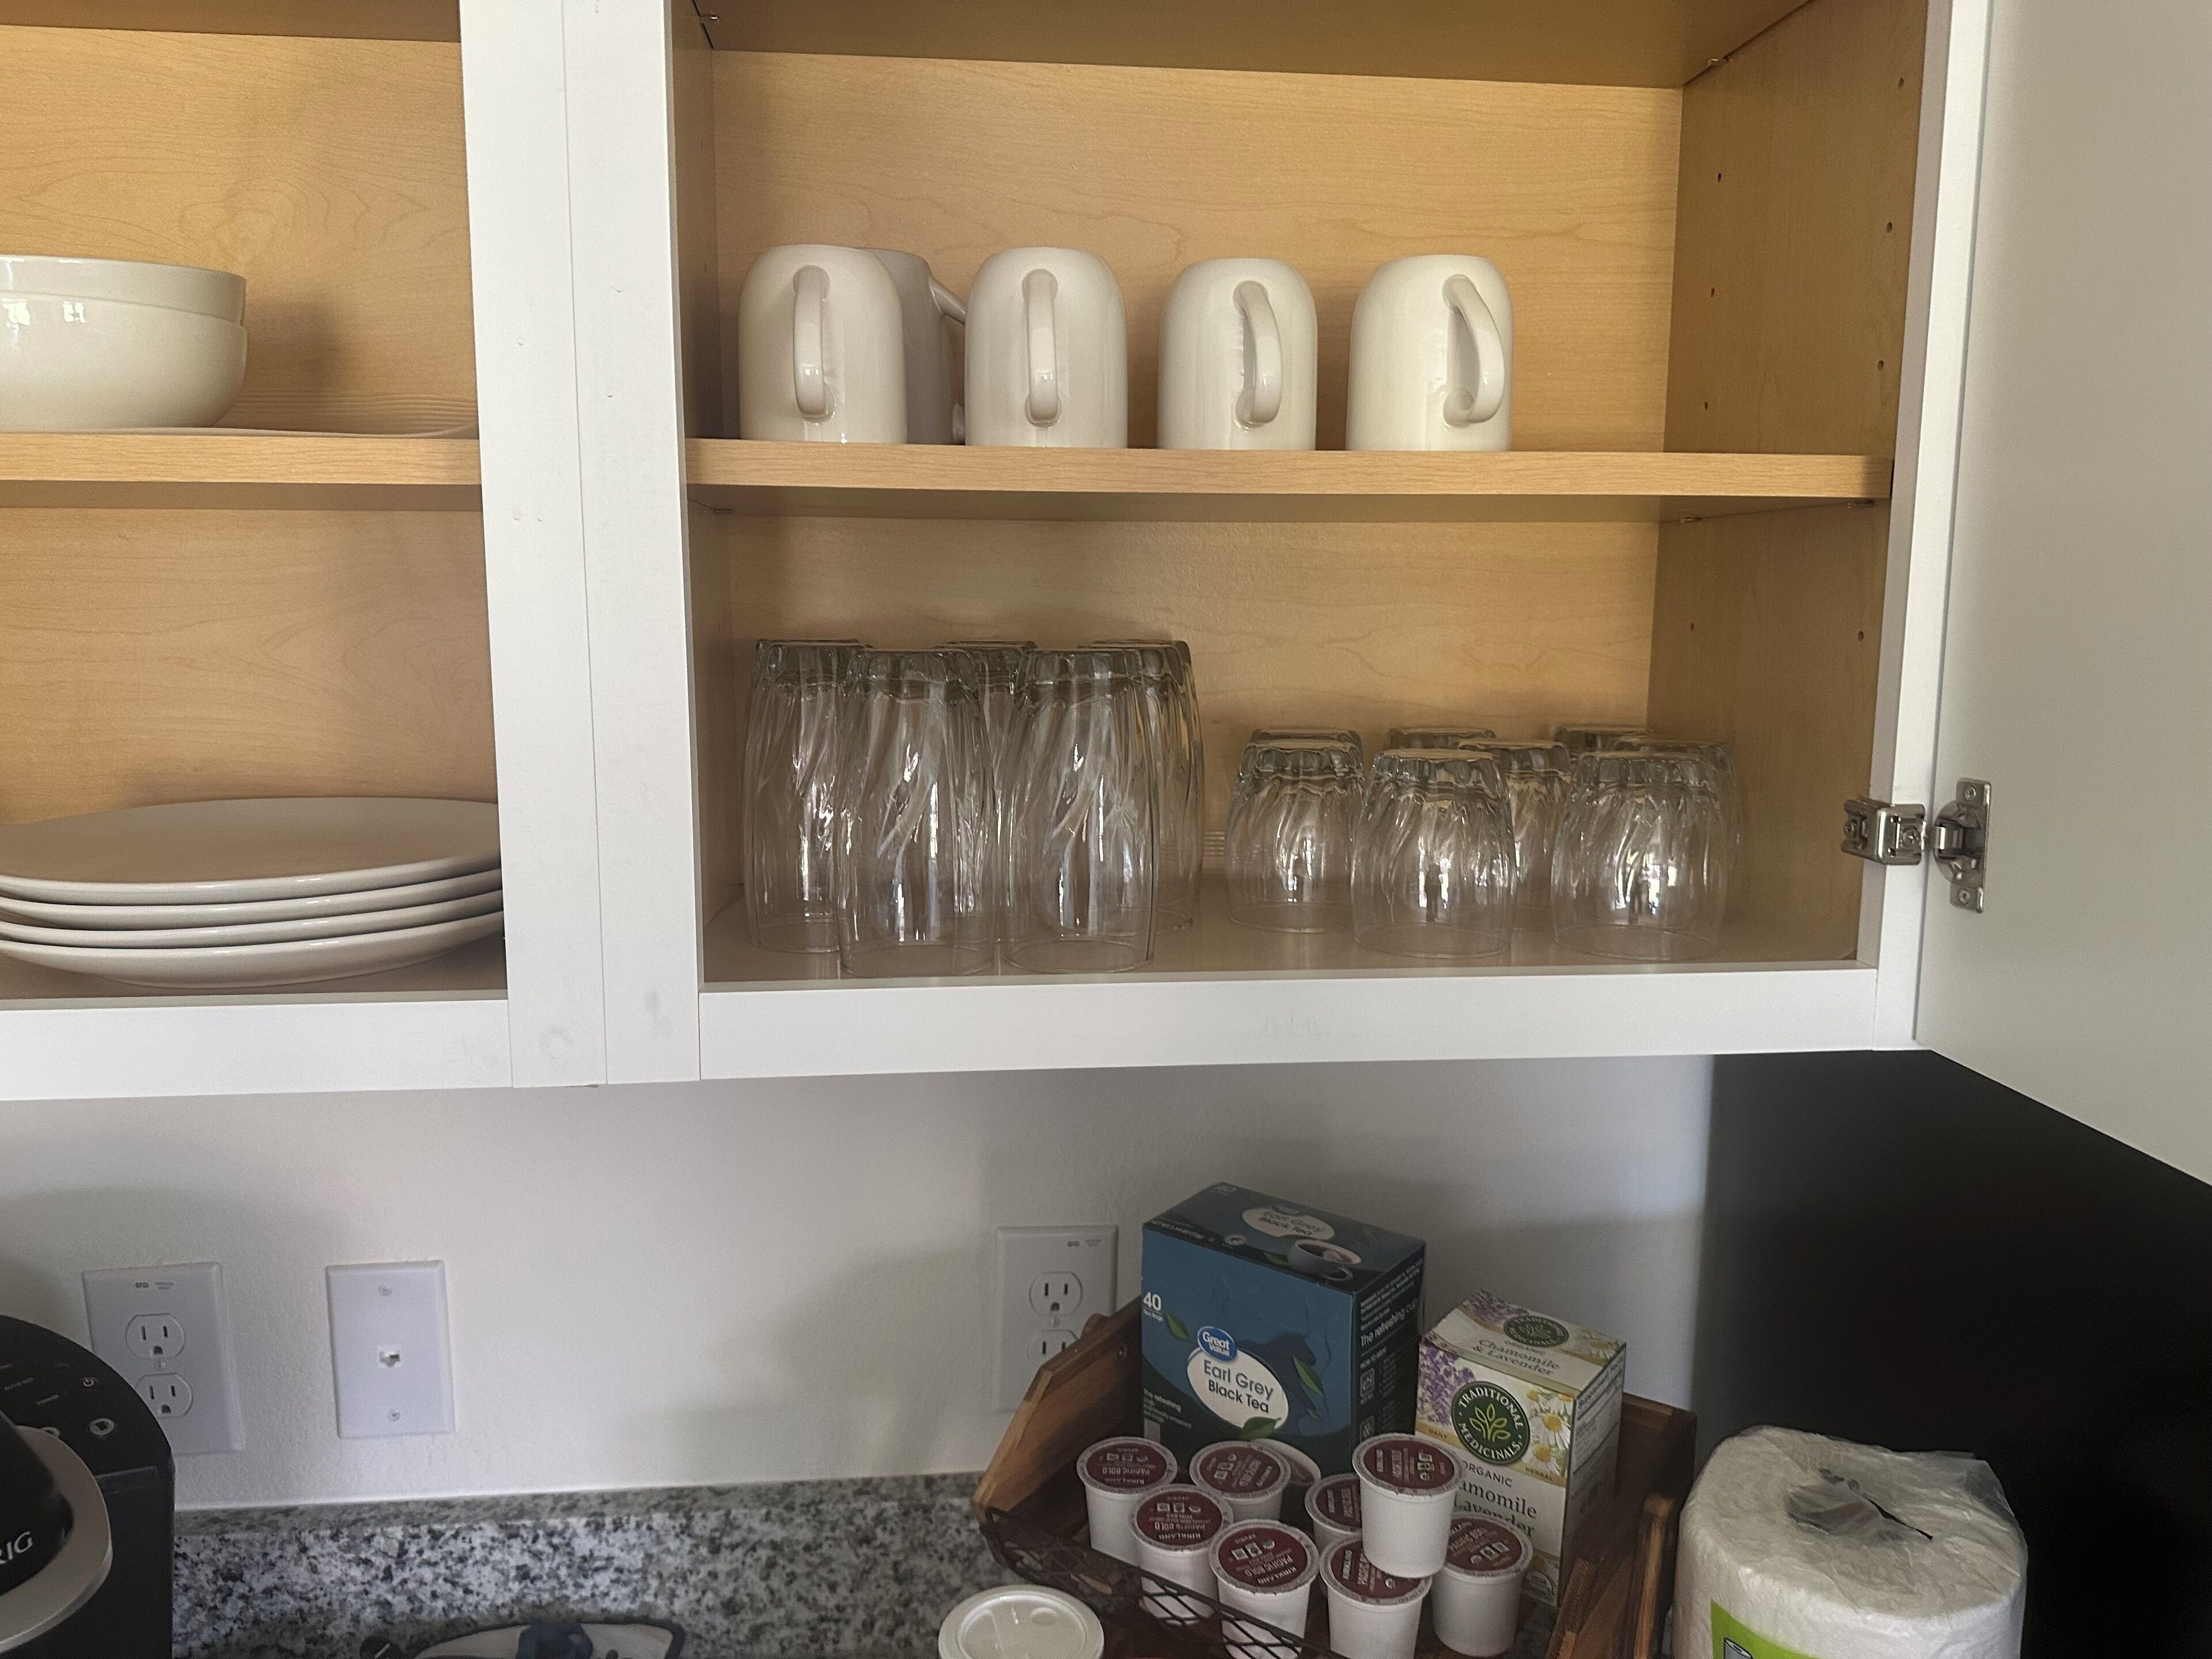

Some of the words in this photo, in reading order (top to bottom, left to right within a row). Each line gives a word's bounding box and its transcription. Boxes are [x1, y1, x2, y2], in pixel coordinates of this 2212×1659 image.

[1143, 1291, 1162, 1311] 40
[1202, 1331, 1230, 1350] Great
[1209, 1341, 1230, 1357] Value
[1479, 1339, 1560, 1369] Chamomile
[1487, 1350, 1554, 1375] Lavender
[1203, 1359, 1231, 1382] Earl
[1235, 1373, 1274, 1401] Grey
[1208, 1379, 1243, 1404] Black
[1245, 1393, 1269, 1414] Tea
[1458, 1387, 1524, 1430] TRADITIONAL
[1458, 1422, 1521, 1460] MEDICINALS
[1459, 1479, 1537, 1519] amomile
[1257, 1566, 1297, 1585] KIRKLAND
[1263, 1555, 1293, 1571] PACIFIC
